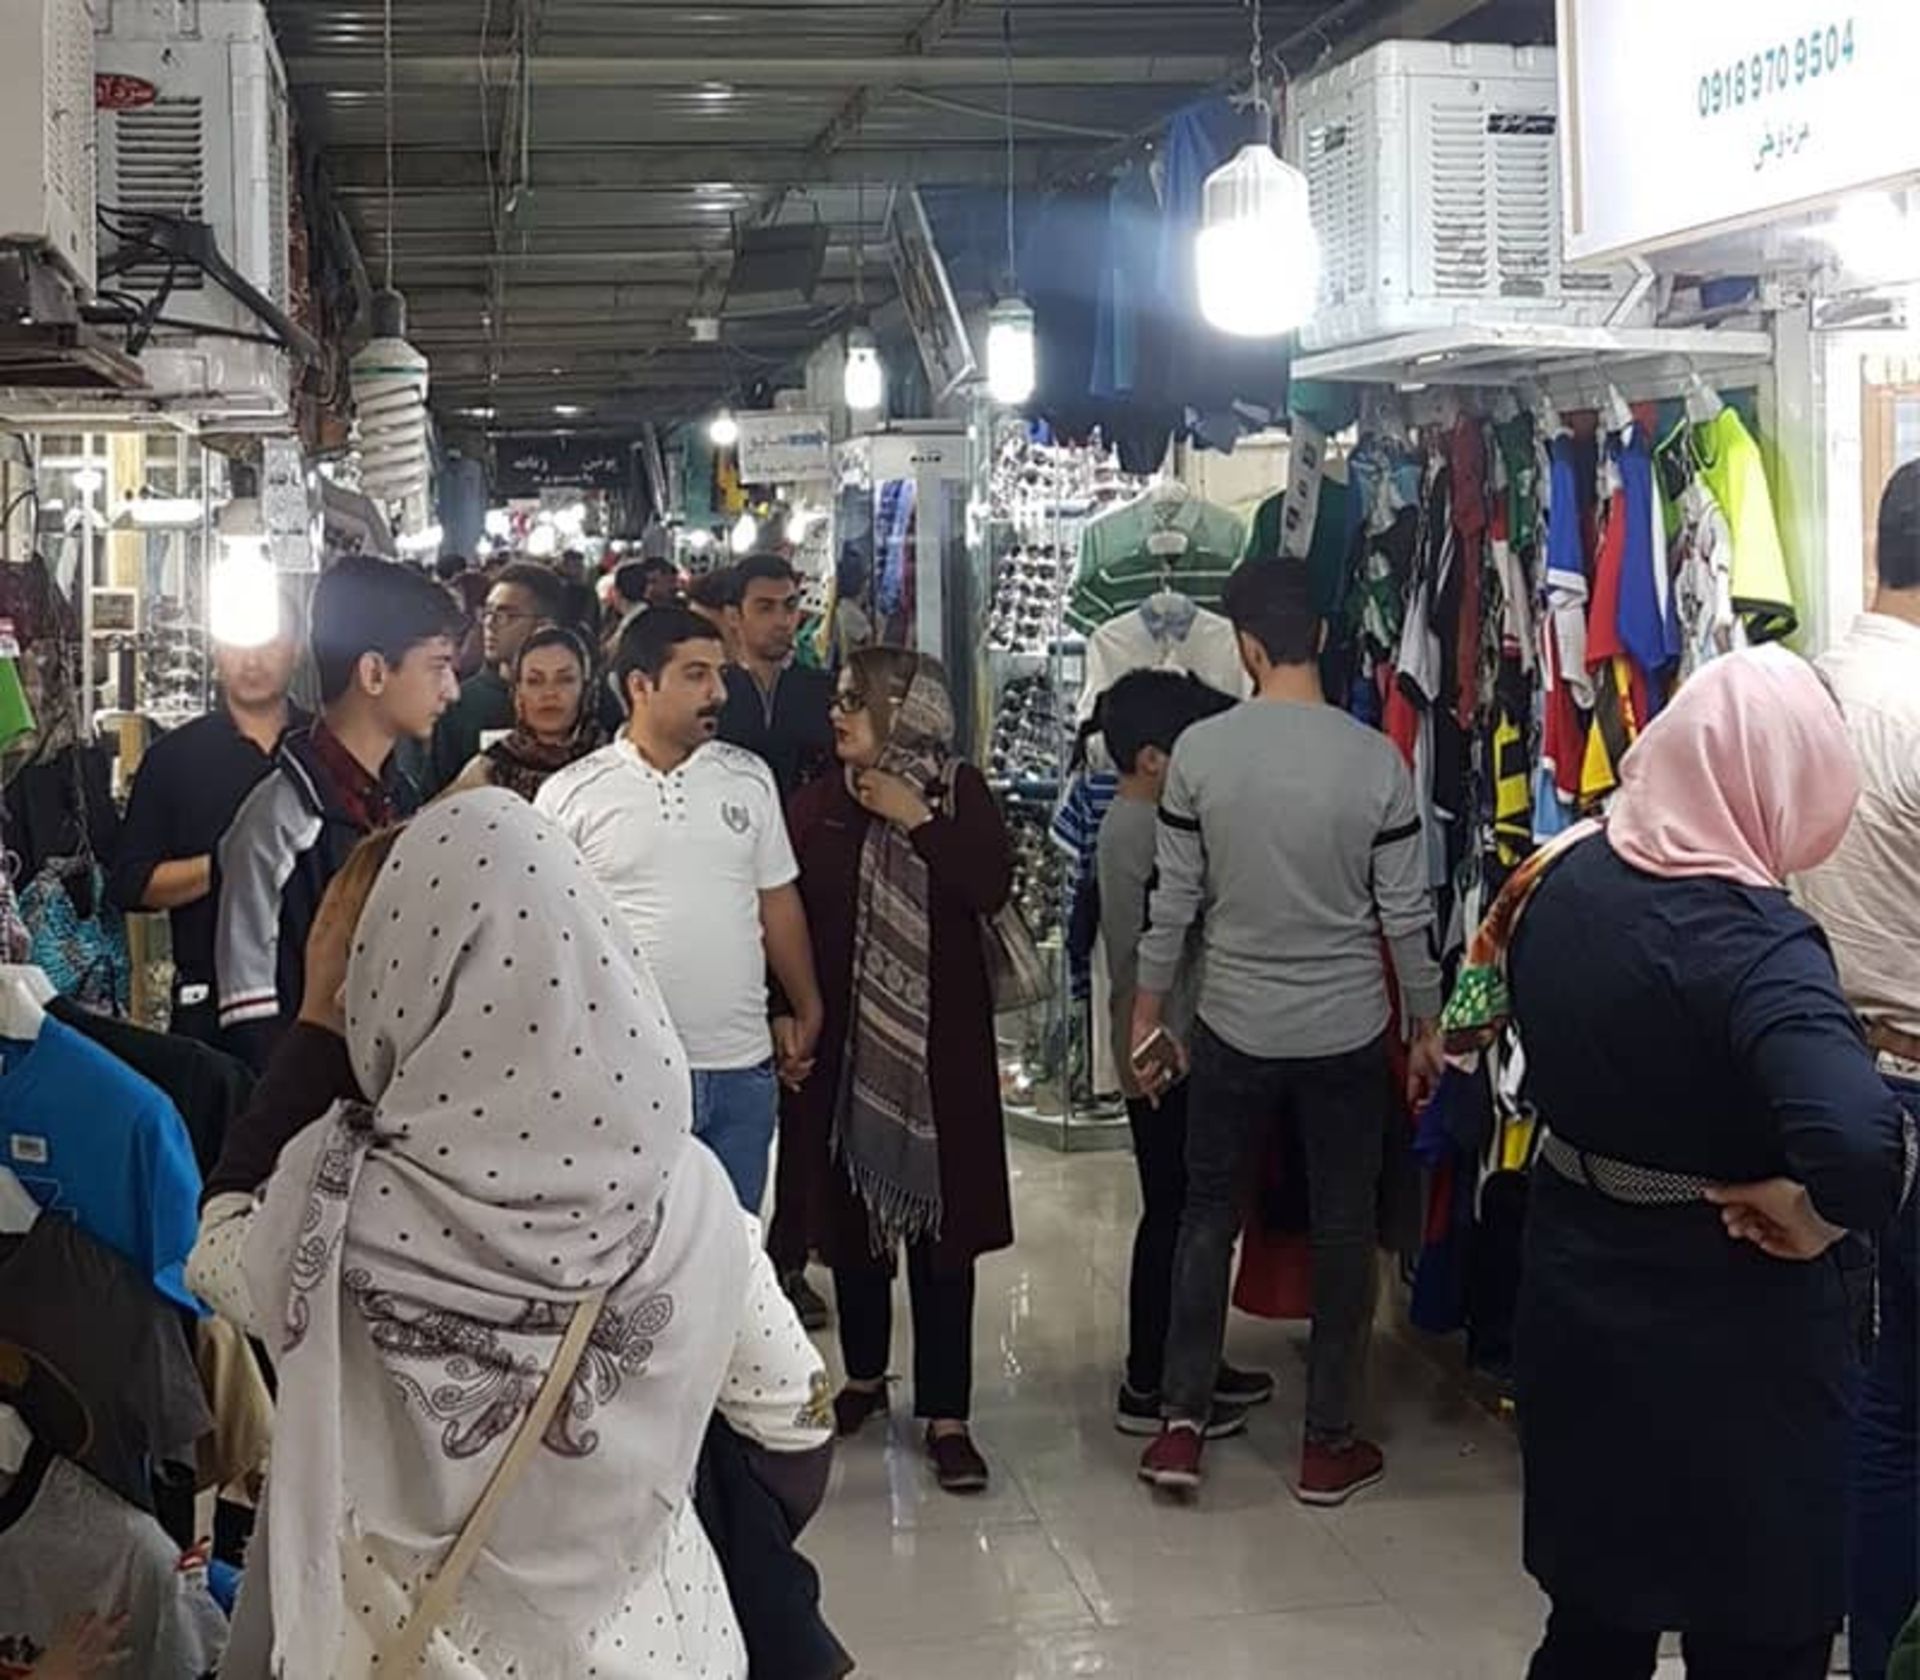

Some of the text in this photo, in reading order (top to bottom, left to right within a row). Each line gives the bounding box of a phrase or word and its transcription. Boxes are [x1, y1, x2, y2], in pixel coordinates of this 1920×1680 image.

[1698, 17, 1854, 119] 0918 970 9504
